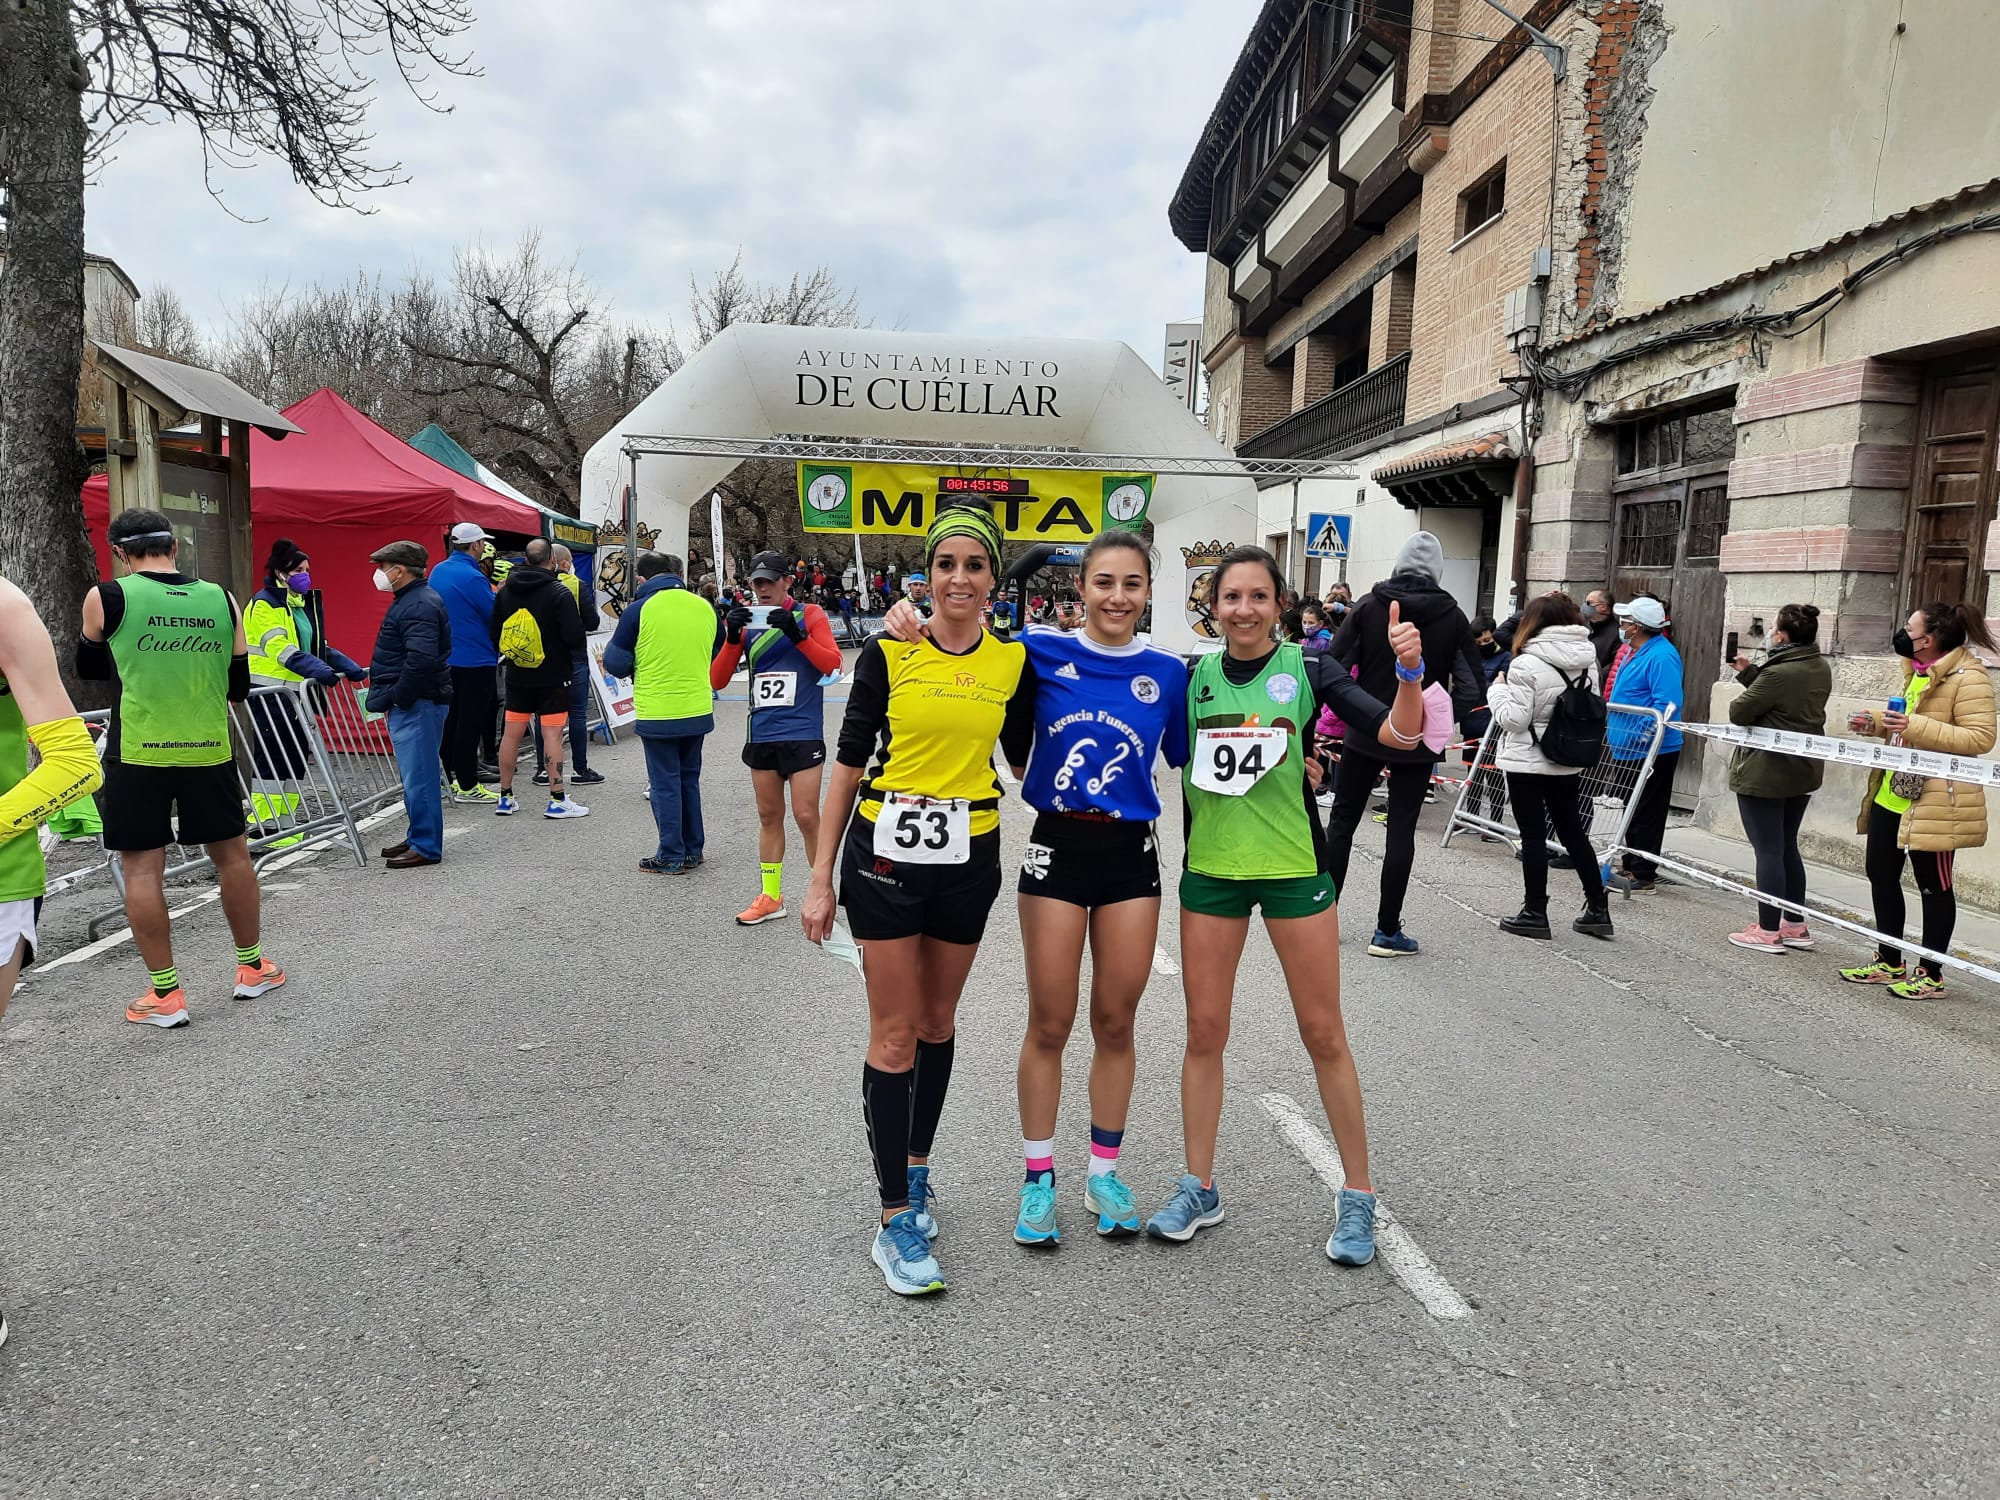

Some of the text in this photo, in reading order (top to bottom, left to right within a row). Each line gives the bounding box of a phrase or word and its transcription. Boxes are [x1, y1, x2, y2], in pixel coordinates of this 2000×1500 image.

[798, 350, 1059, 377] AYUNTAMIENTO
[795, 373, 1062, 417] DE CUÉLLAR
[946, 479, 1009, 492] 00:45:56
[863, 489, 1094, 535] MTA
[148, 616, 215, 629] ATLETISMO
[137, 633, 223, 654] Cuéllar
[759, 679, 786, 700] 52
[142, 740, 222, 749] www.atletismocuellar.es
[1047, 709, 1145, 758] Agencia Funeraria
[1213, 744, 1266, 782] 94
[894, 810, 950, 850] 53
